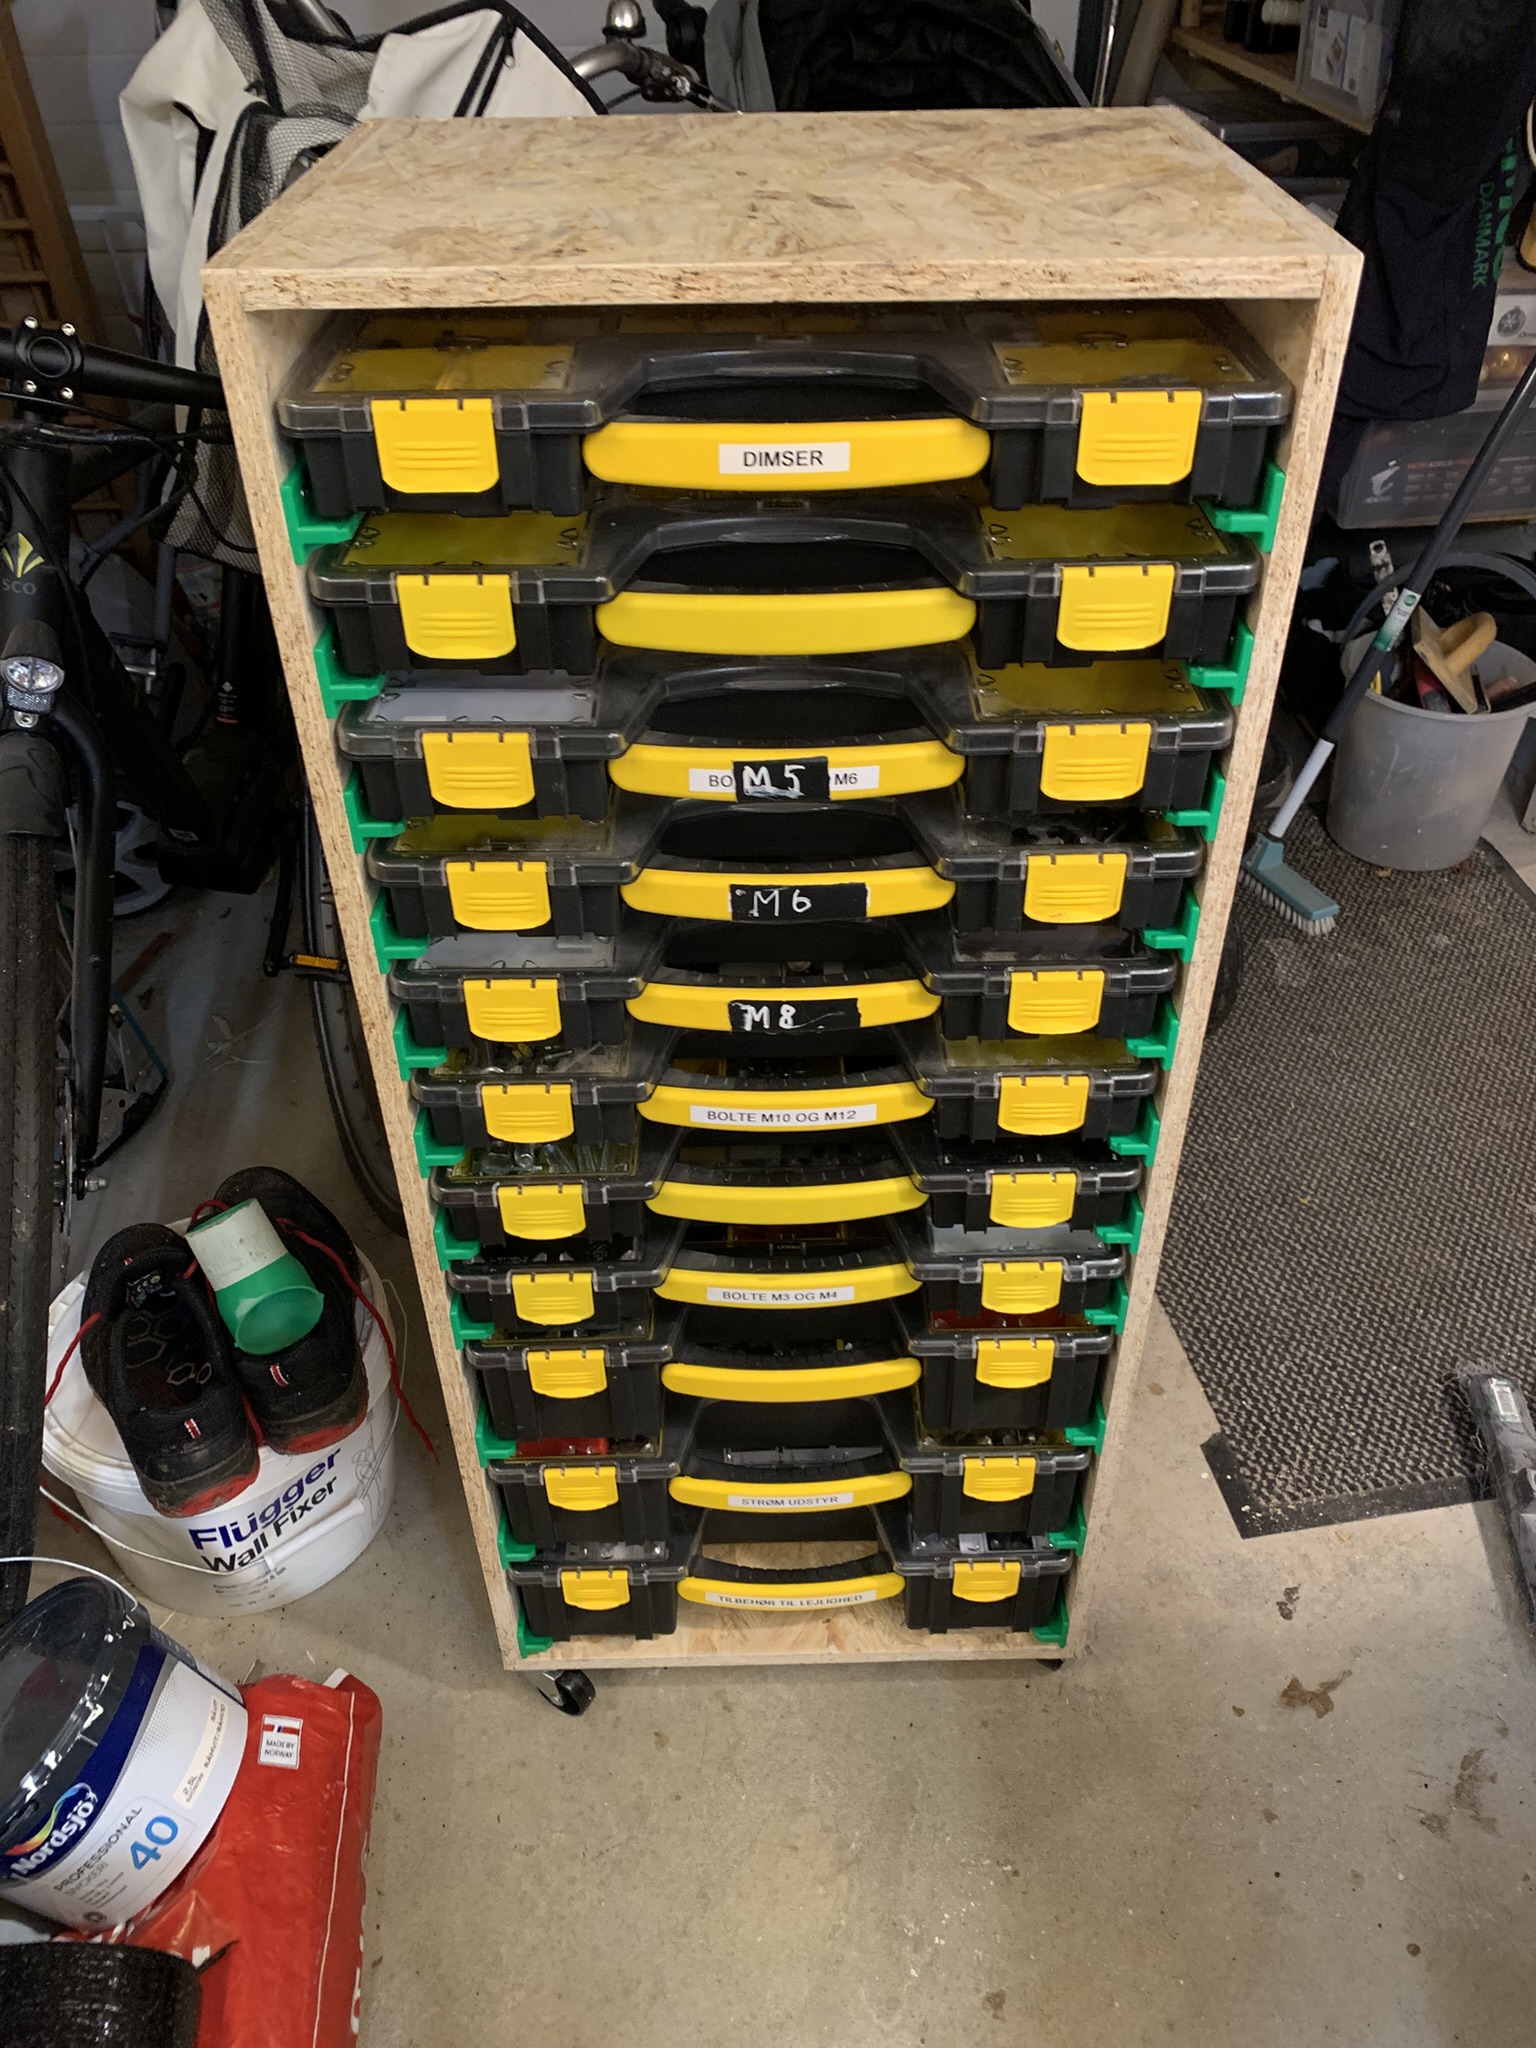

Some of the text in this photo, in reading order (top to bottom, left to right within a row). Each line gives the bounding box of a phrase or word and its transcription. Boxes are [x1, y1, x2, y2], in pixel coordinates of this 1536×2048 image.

[1472, 182, 1494, 291] DANMARK
[743, 450, 824, 468] DIMSER
[2, 578, 37, 595] SCO
[834, 773, 857, 785] M6
[707, 1110, 857, 1123] BOLTE M10 OG M12
[722, 1291, 838, 1302] BOLTE M3 OG M4
[188, 1448, 341, 1551] Flügger
[741, 1495, 839, 1506] STRØM UDSTYR
[201, 1475, 338, 1572] Wall Fixer
[718, 1595, 776, 1606] TILBEHØR
[800, 1595, 863, 1606] LEJLIGHED
[266, 1739, 285, 1748] MADE
[264, 1749, 293, 1758] NORWAY
[11, 1798, 96, 1877] Nordsjö
[130, 1815, 179, 1871] 40
[54, 1806, 143, 1893] PROFESSIONAL
